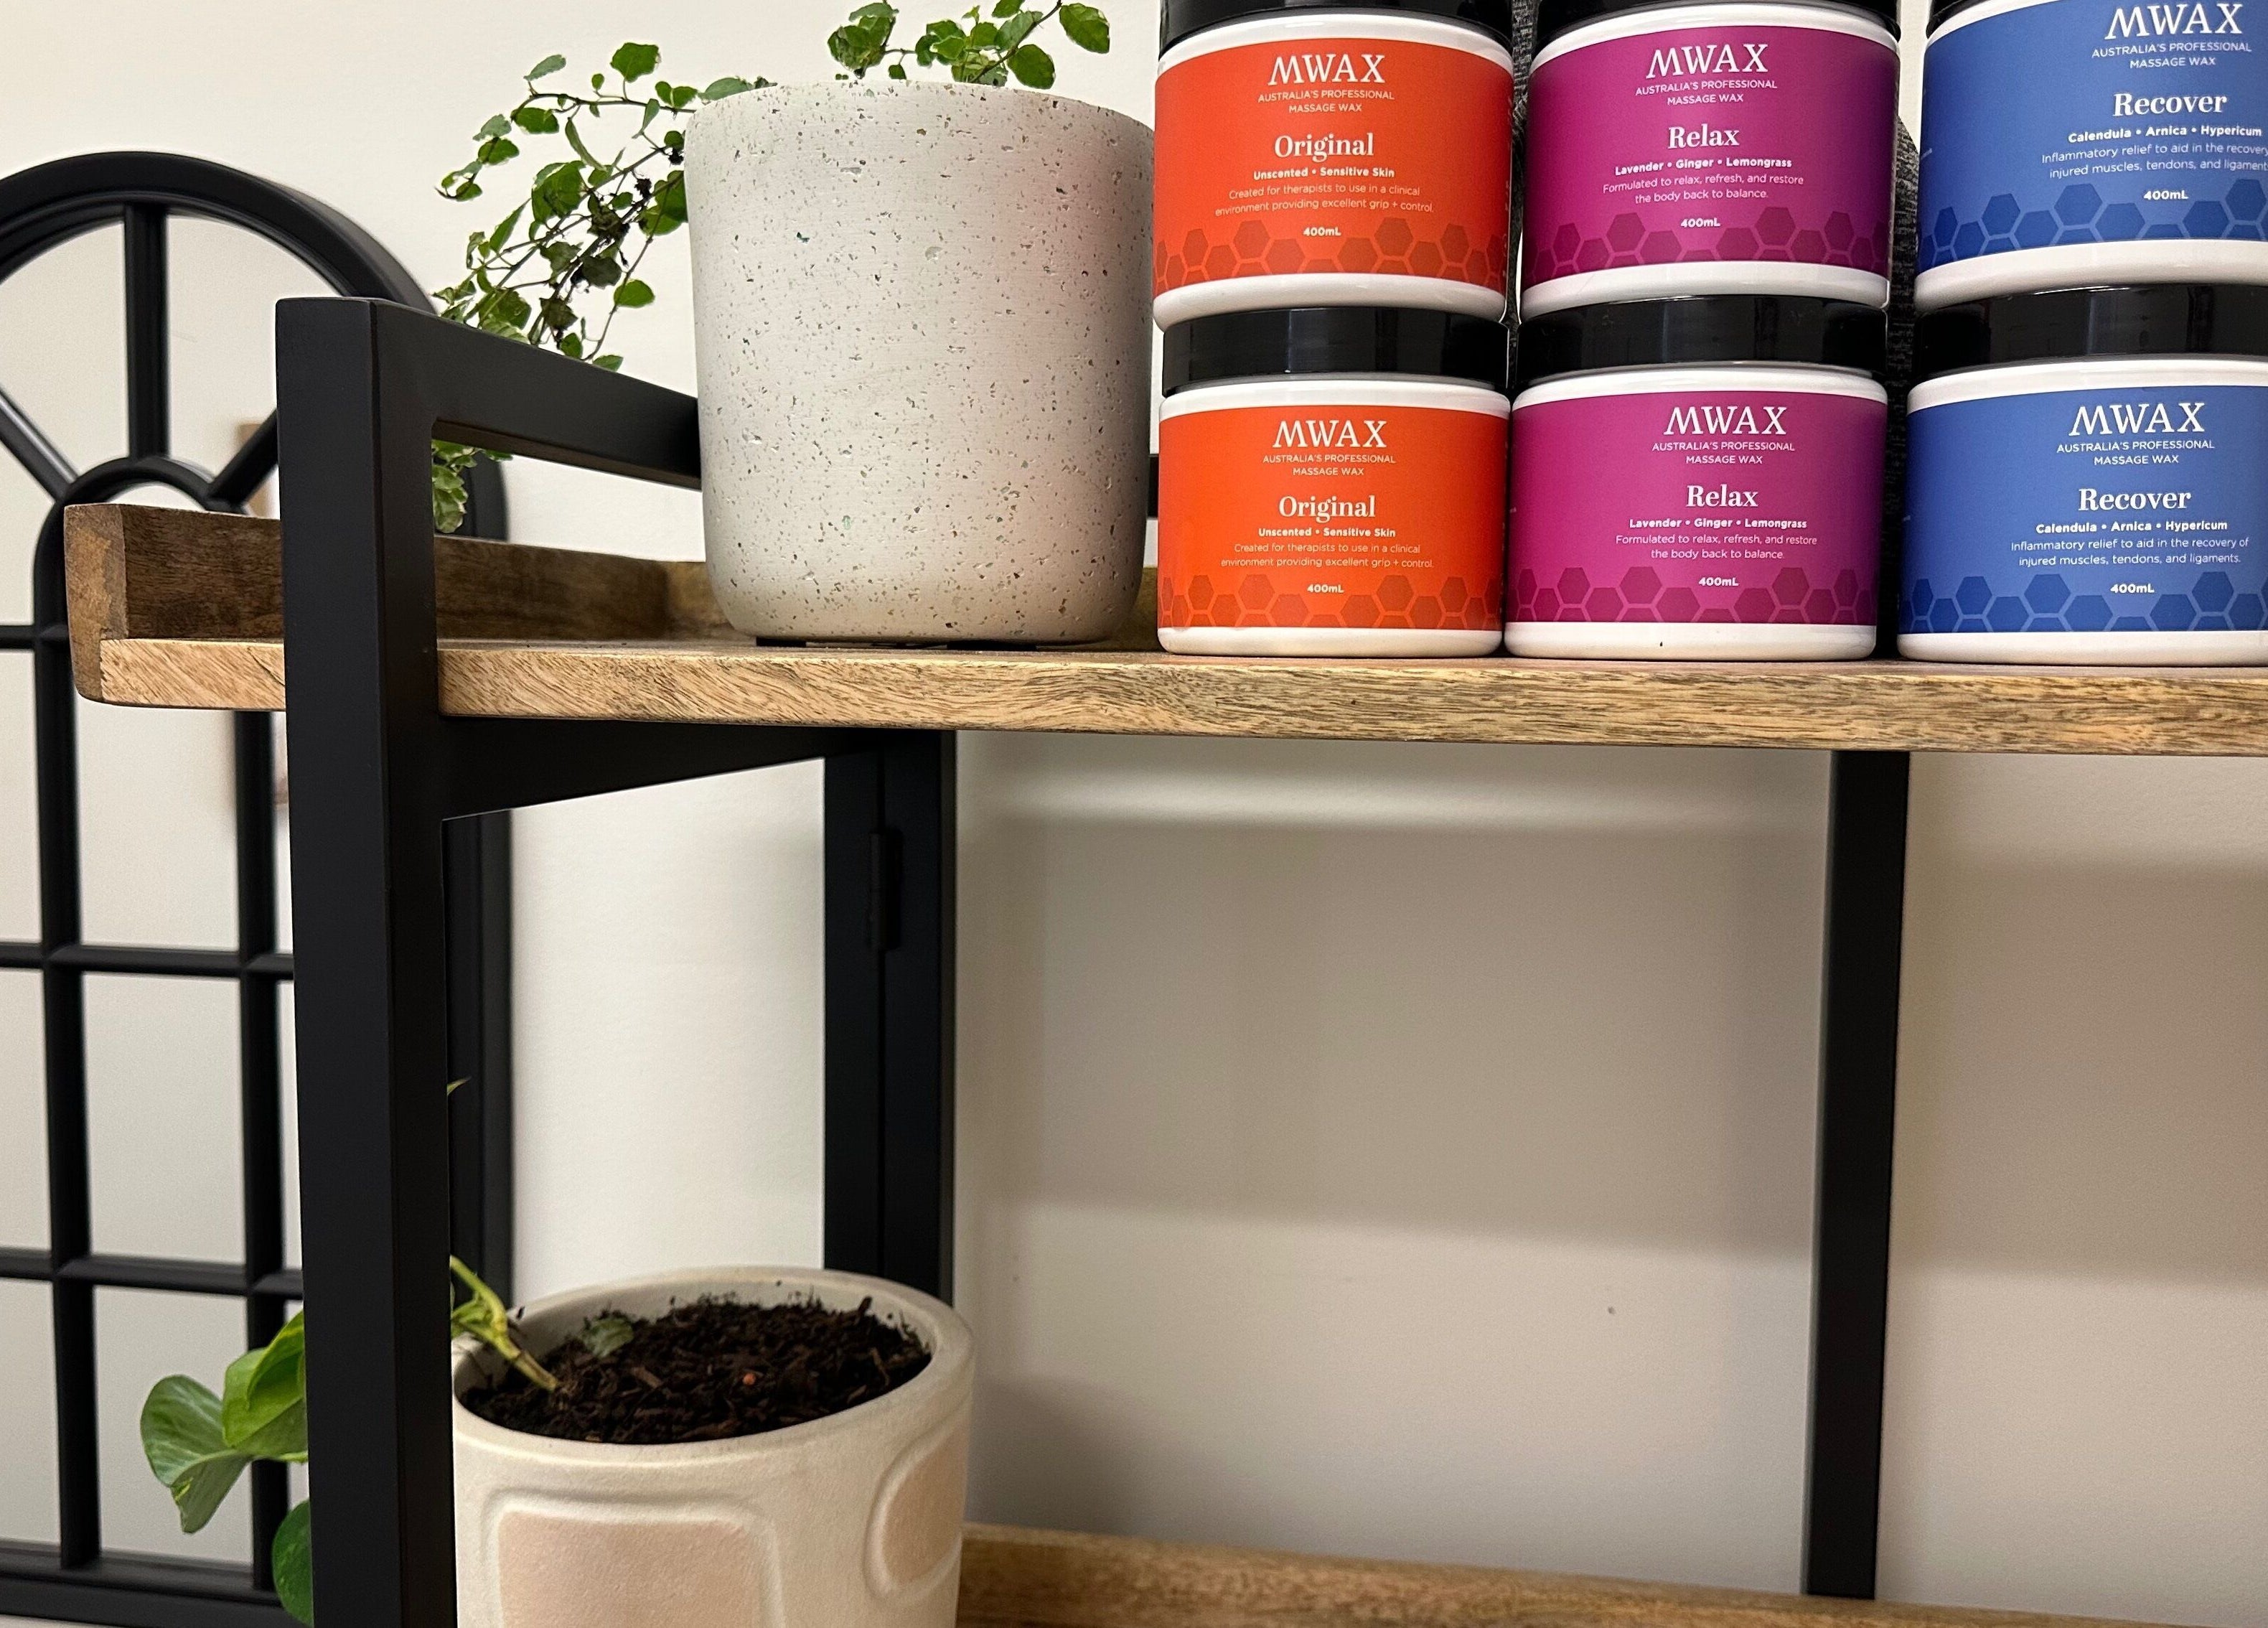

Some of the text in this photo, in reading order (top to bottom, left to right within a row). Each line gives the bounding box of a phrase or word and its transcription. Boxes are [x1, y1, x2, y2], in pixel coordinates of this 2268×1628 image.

[2104, 3, 2243, 40] MWAX
[2091, 42, 2252, 58] AUSTRALIA'S PROFESSIONAL
[1646, 44, 1768, 79] MWAX
[2129, 57, 2216, 69] MASSAGE WAX
[1267, 53, 1385, 85] MWAX
[1635, 79, 1778, 96] AUSTRALIA'S PROFESSIONAL
[1257, 89, 1395, 103] AUSTRALIA'S PROFESSIONAL
[1667, 93, 1744, 106] MASSAGE WAX
[1288, 103, 1362, 113] MASSAGE WAX
[2112, 93, 2228, 117] Recover
[1668, 123, 1740, 149] Relax
[2068, 125, 2262, 143] Calendula Arnica Hypericum
[1274, 132, 1373, 163] Original
[2042, 142, 2268, 164] Inflammatory relief to aid in the recovery
[1253, 166, 1395, 181] Unscented Sensitive Skin
[1615, 157, 1792, 176] Lavender Ginger Lemongrass
[2050, 159, 2268, 179] injured muscles, tendons, and ligament
[1603, 173, 1804, 194] Formulated to relax, refresh, and restore
[1229, 186, 1265, 200] Created
[1266, 185, 1281, 195] for
[1283, 183, 1332, 195] therapists
[1335, 183, 1346, 193] to
[1349, 184, 1367, 193] use
[1369, 183, 1378, 193] in
[1388, 184, 1420, 196] clinical
[1635, 194, 1651, 204] the
[1654, 191, 1681, 202] body
[1683, 189, 1709, 200] back
[1711, 189, 1723, 199] to
[2143, 190, 2189, 200] 400mL
[1215, 201, 1270, 217] environment
[1272, 199, 1319, 212] providing
[1321, 197, 1367, 208] excellent
[1369, 200, 1390, 210] grip
[1680, 217, 1721, 228] 400mL
[1303, 226, 1341, 236] 400mL
[1663, 406, 1787, 435] MWAX
[2068, 402, 2205, 436] MWAX
[1273, 420, 1387, 448] MWAX
[1651, 441, 1795, 452] AUSTRALIA'S PROFESSIONAL
[2056, 440, 2215, 453] AUSTRALIA'S PROFESSIONAL
[1262, 454, 1395, 464] AUSTRALIA'S PROFESSIONAL
[1685, 454, 1763, 464] MASSAGE WAX
[2094, 454, 2179, 466] MASSAGE WAX
[1293, 467, 1364, 476] MASSAGE WAX
[1686, 484, 1758, 507] Relax
[2078, 488, 2192, 511] Recover
[1279, 495, 1375, 523] Original
[1629, 518, 1807, 530] Lavender Ginger Lemongrass
[2035, 520, 2228, 534] Calendula Arnica Hypericum
[1258, 527, 1396, 538] Unscented Sensitive Skin
[1616, 533, 1817, 545] Formulated to relax, refresh, and restore
[1234, 543, 1269, 552] Created
[1271, 542, 1285, 552] for
[1287, 543, 1336, 553] therapists
[1338, 543, 1349, 553] to
[1370, 544, 1380, 553] in
[1390, 543, 1420, 553] clinical
[2011, 541, 2086, 551] Inflammatory
[2088, 538, 2118, 549] relief
[2120, 539, 2133, 548] to
[2136, 538, 2154, 548] aid
[2170, 538, 2189, 548] the
[2191, 539, 2237, 549] recovery
[2239, 537, 2249, 548] of
[1651, 549, 1669, 558] the
[1671, 548, 1700, 560] body
[1701, 548, 1728, 558] back
[1730, 549, 1742, 558] to
[2019, 556, 2056, 568] injured
[2059, 555, 2109, 565] muscles,
[2112, 553, 2162, 564] tendons,
[2165, 553, 2187, 563] and
[1221, 558, 1274, 567] environment
[1276, 557, 1323, 568] providing
[1325, 557, 1369, 566] excellent
[1371, 558, 1391, 569] grip
[1698, 576, 1739, 586] 400mL
[1307, 584, 1344, 593] 400mL
[2110, 583, 2155, 594] 400mL
